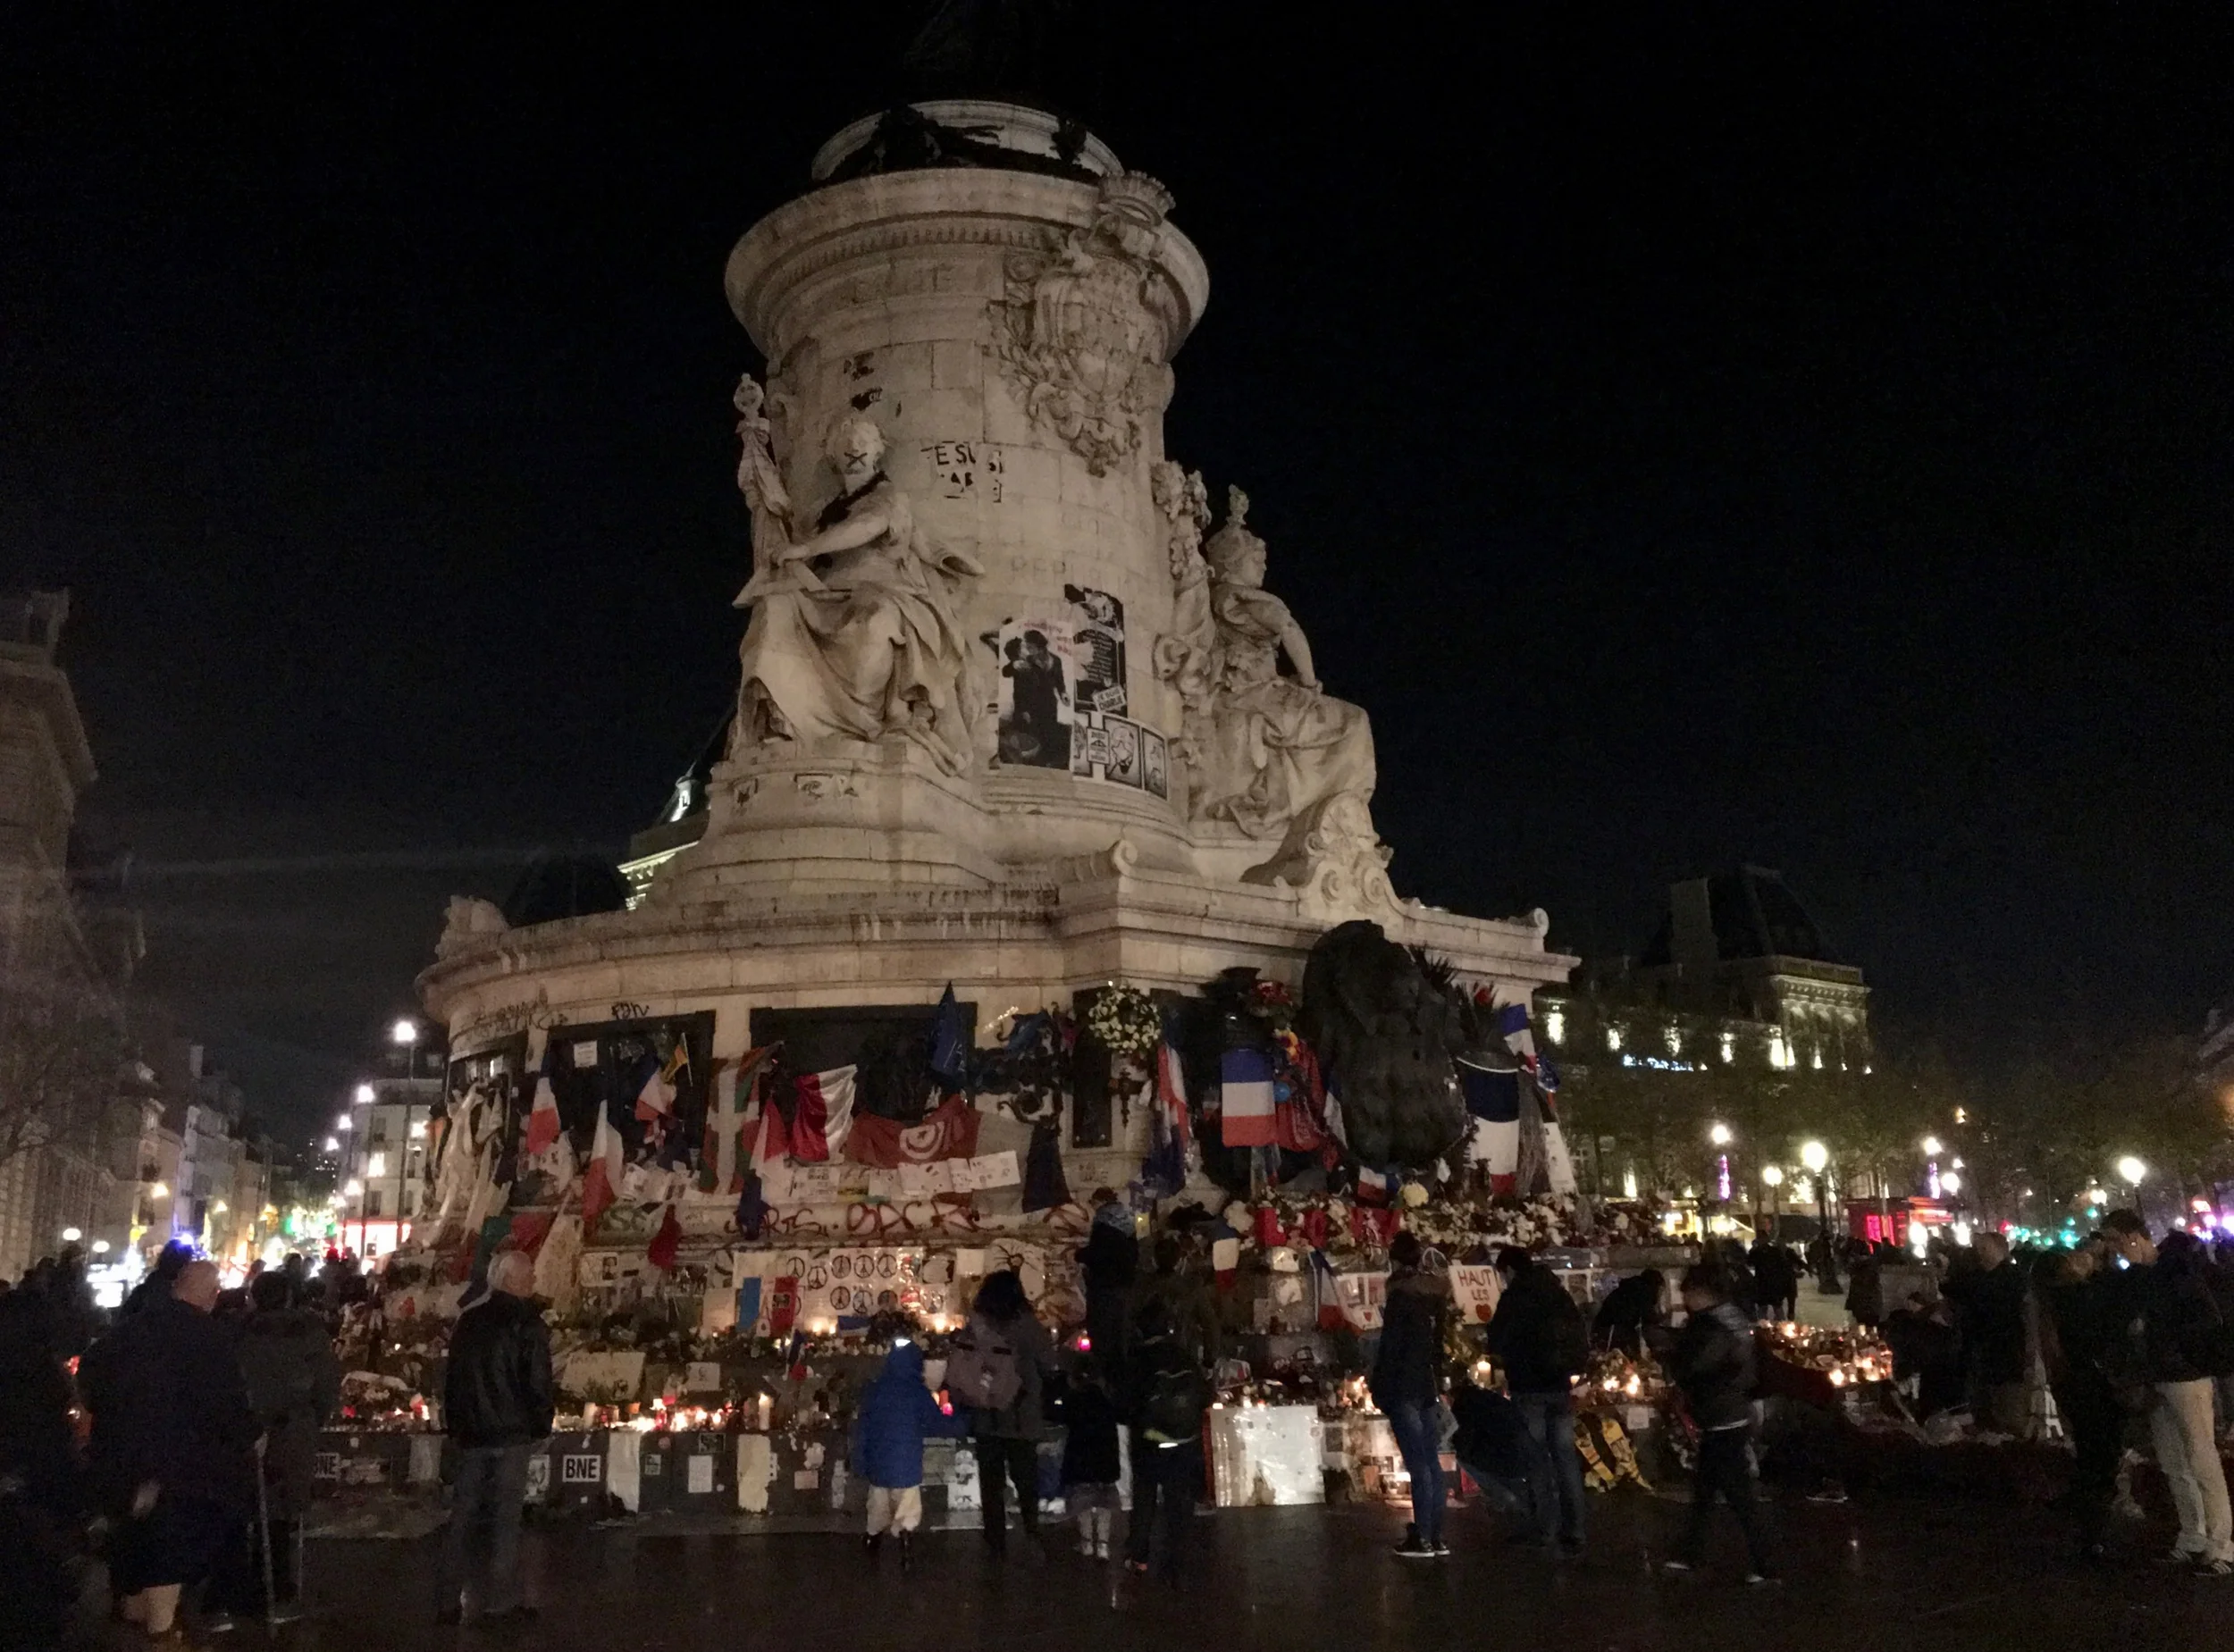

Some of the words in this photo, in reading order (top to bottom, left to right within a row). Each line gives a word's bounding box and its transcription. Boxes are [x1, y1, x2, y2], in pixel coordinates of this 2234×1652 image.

[1457, 1269, 1492, 1287] HAUT
[1471, 1289, 1490, 1301] LES
[566, 1458, 597, 1479] BNE
